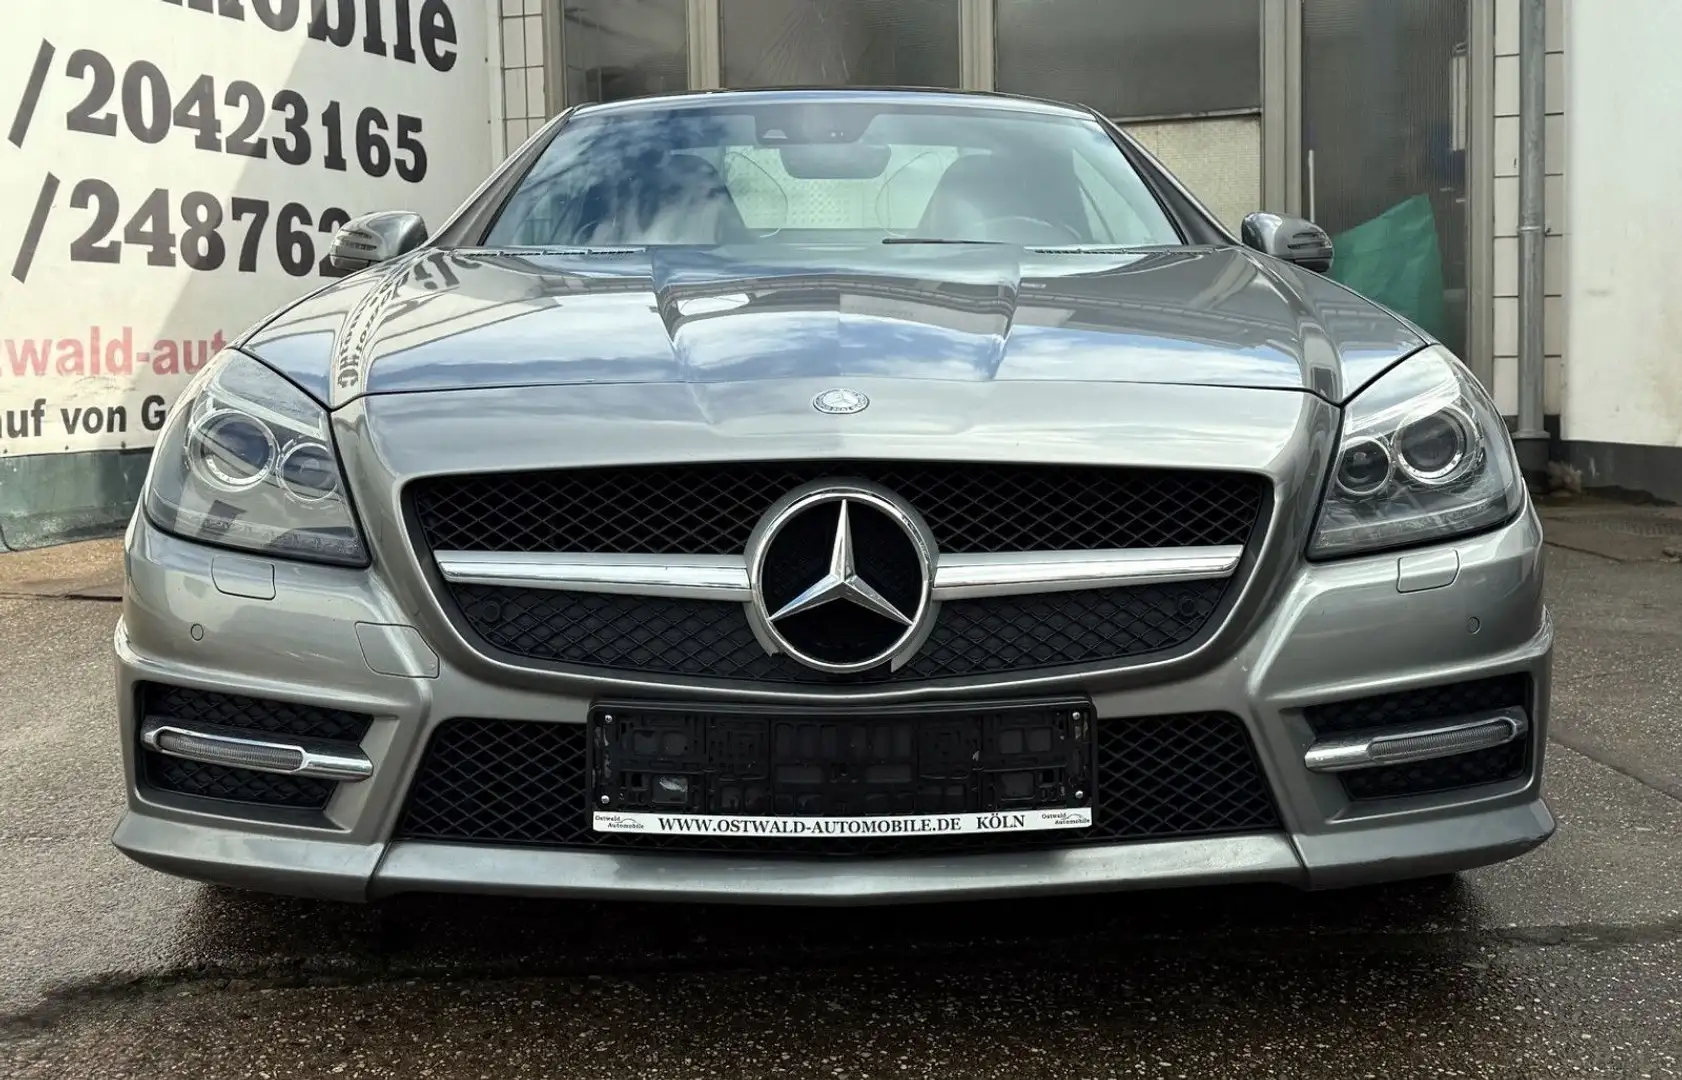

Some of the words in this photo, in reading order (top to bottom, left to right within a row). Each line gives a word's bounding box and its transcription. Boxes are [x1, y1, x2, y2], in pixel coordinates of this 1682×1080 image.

[160, 0, 457, 72] ile
[0, 326, 226, 376] wald-aut
[0, 398, 46, 439] uf
[60, 405, 127, 435] von
[141, 394, 173, 432] G
[658, 817, 962, 834] WWW.OSTWALD-AUTOMOBILE.DE
[976, 812, 1026, 830] KÖLN
